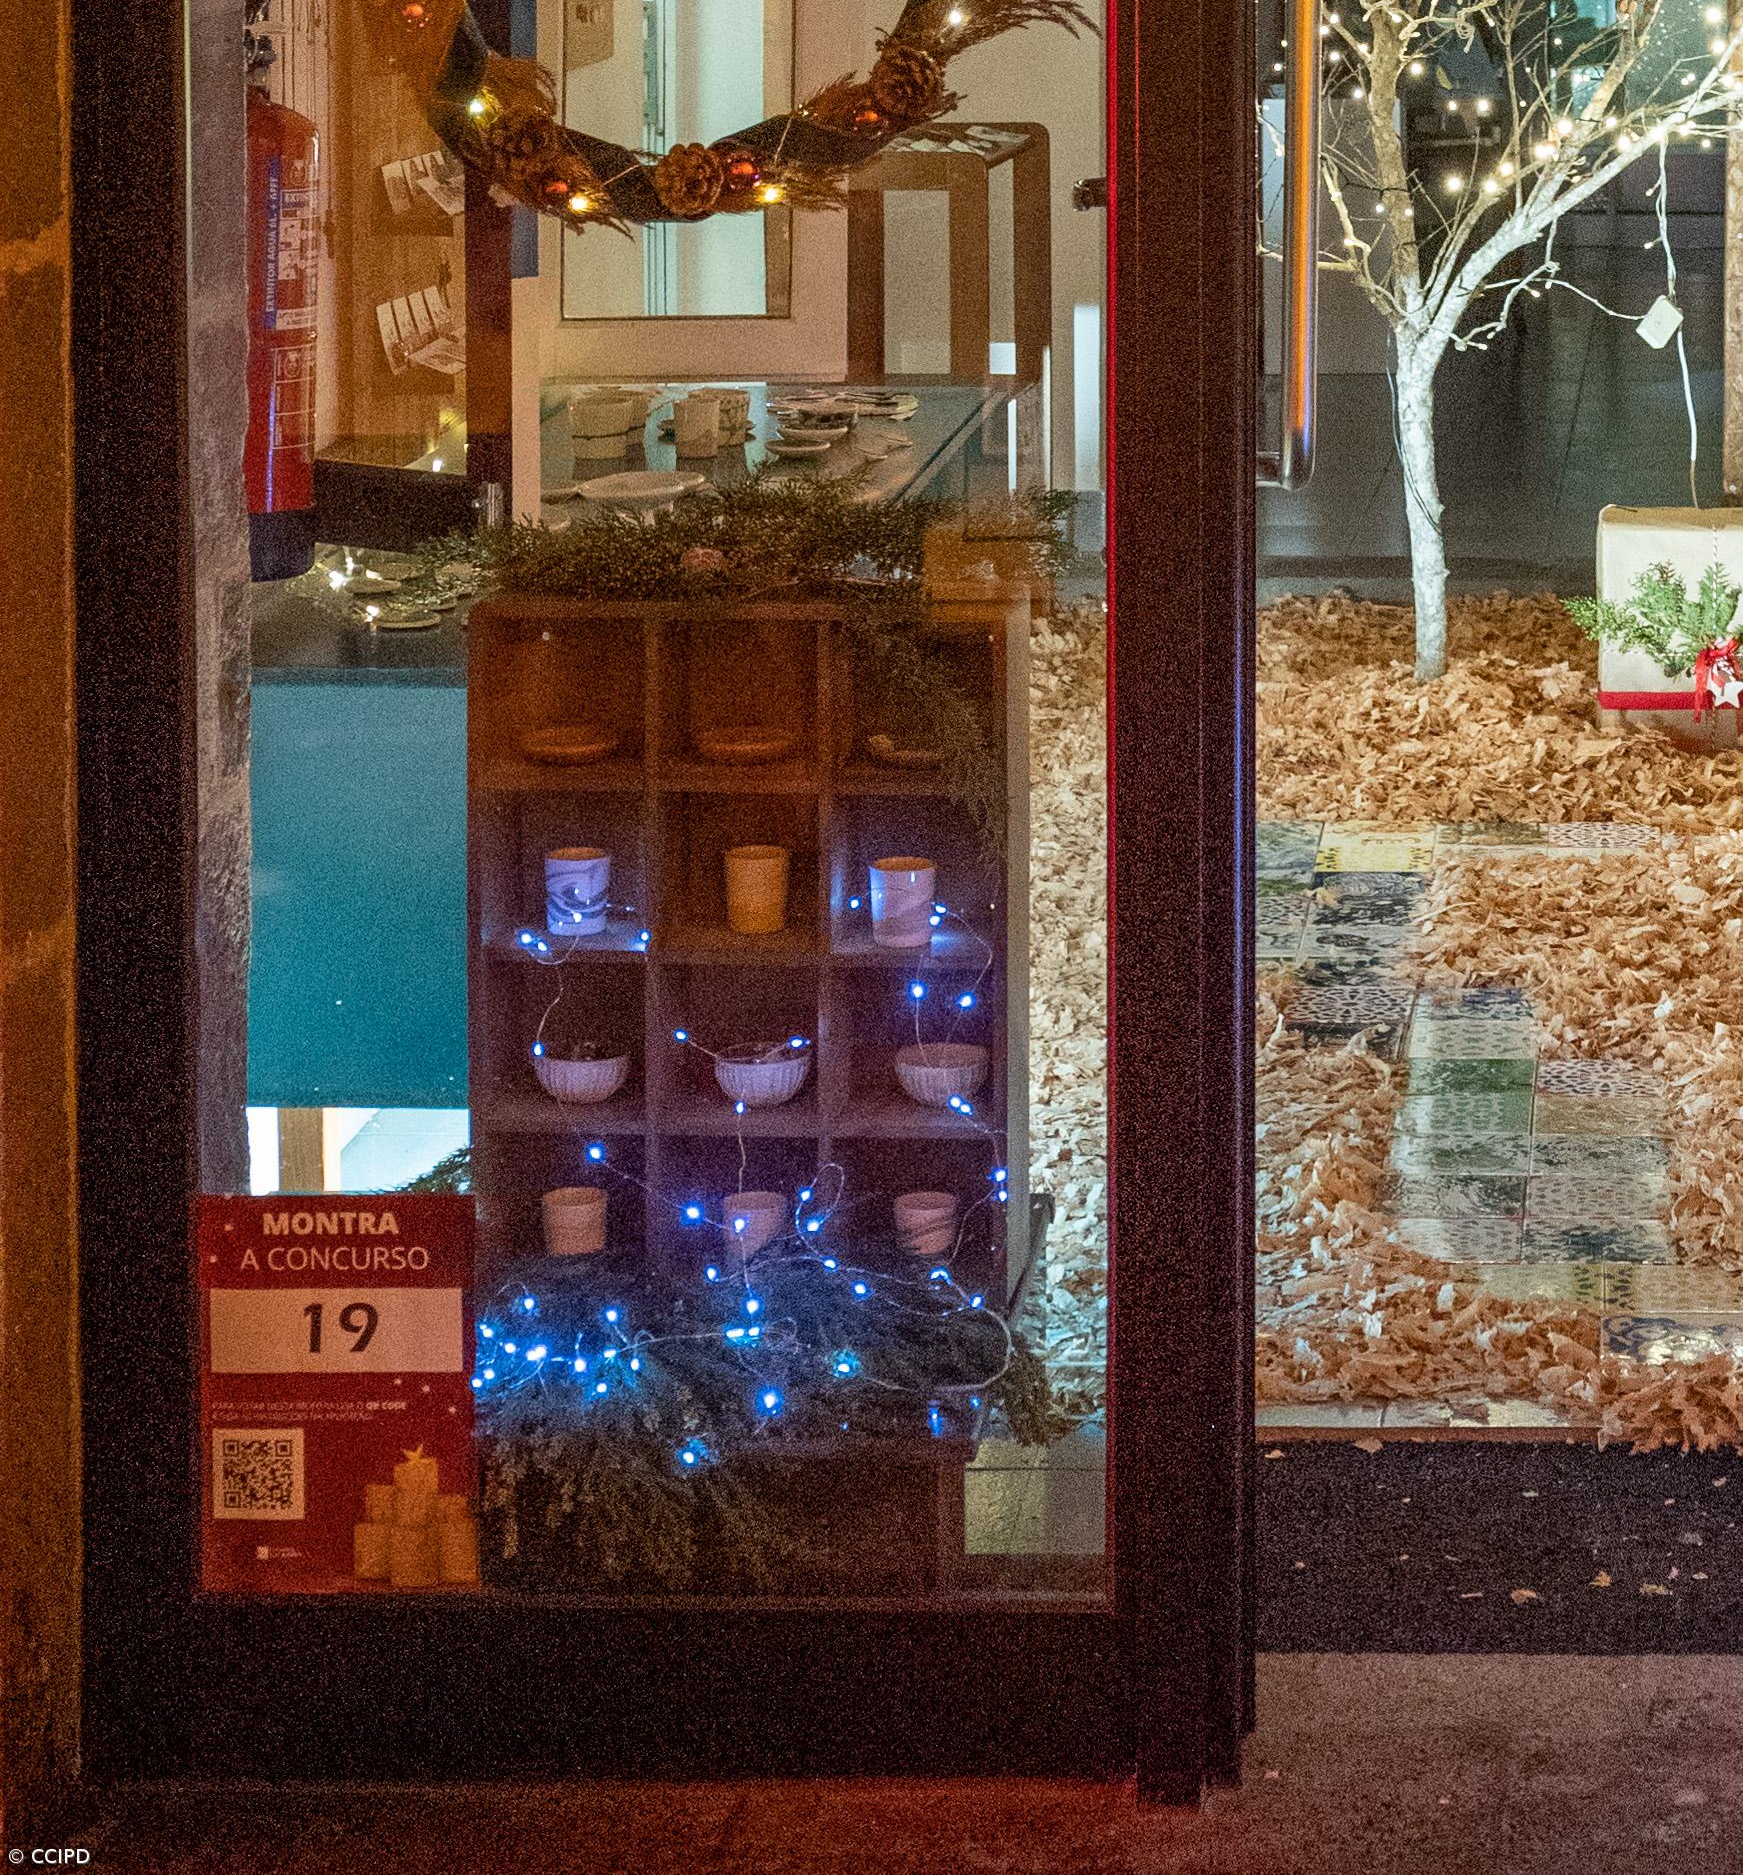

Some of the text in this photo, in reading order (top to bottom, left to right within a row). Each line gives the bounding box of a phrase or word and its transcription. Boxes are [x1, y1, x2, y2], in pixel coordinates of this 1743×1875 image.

[262, 1212, 400, 1235] MONTRA
[240, 1246, 430, 1271] A CONCURSO
[303, 1302, 379, 1354] 19
